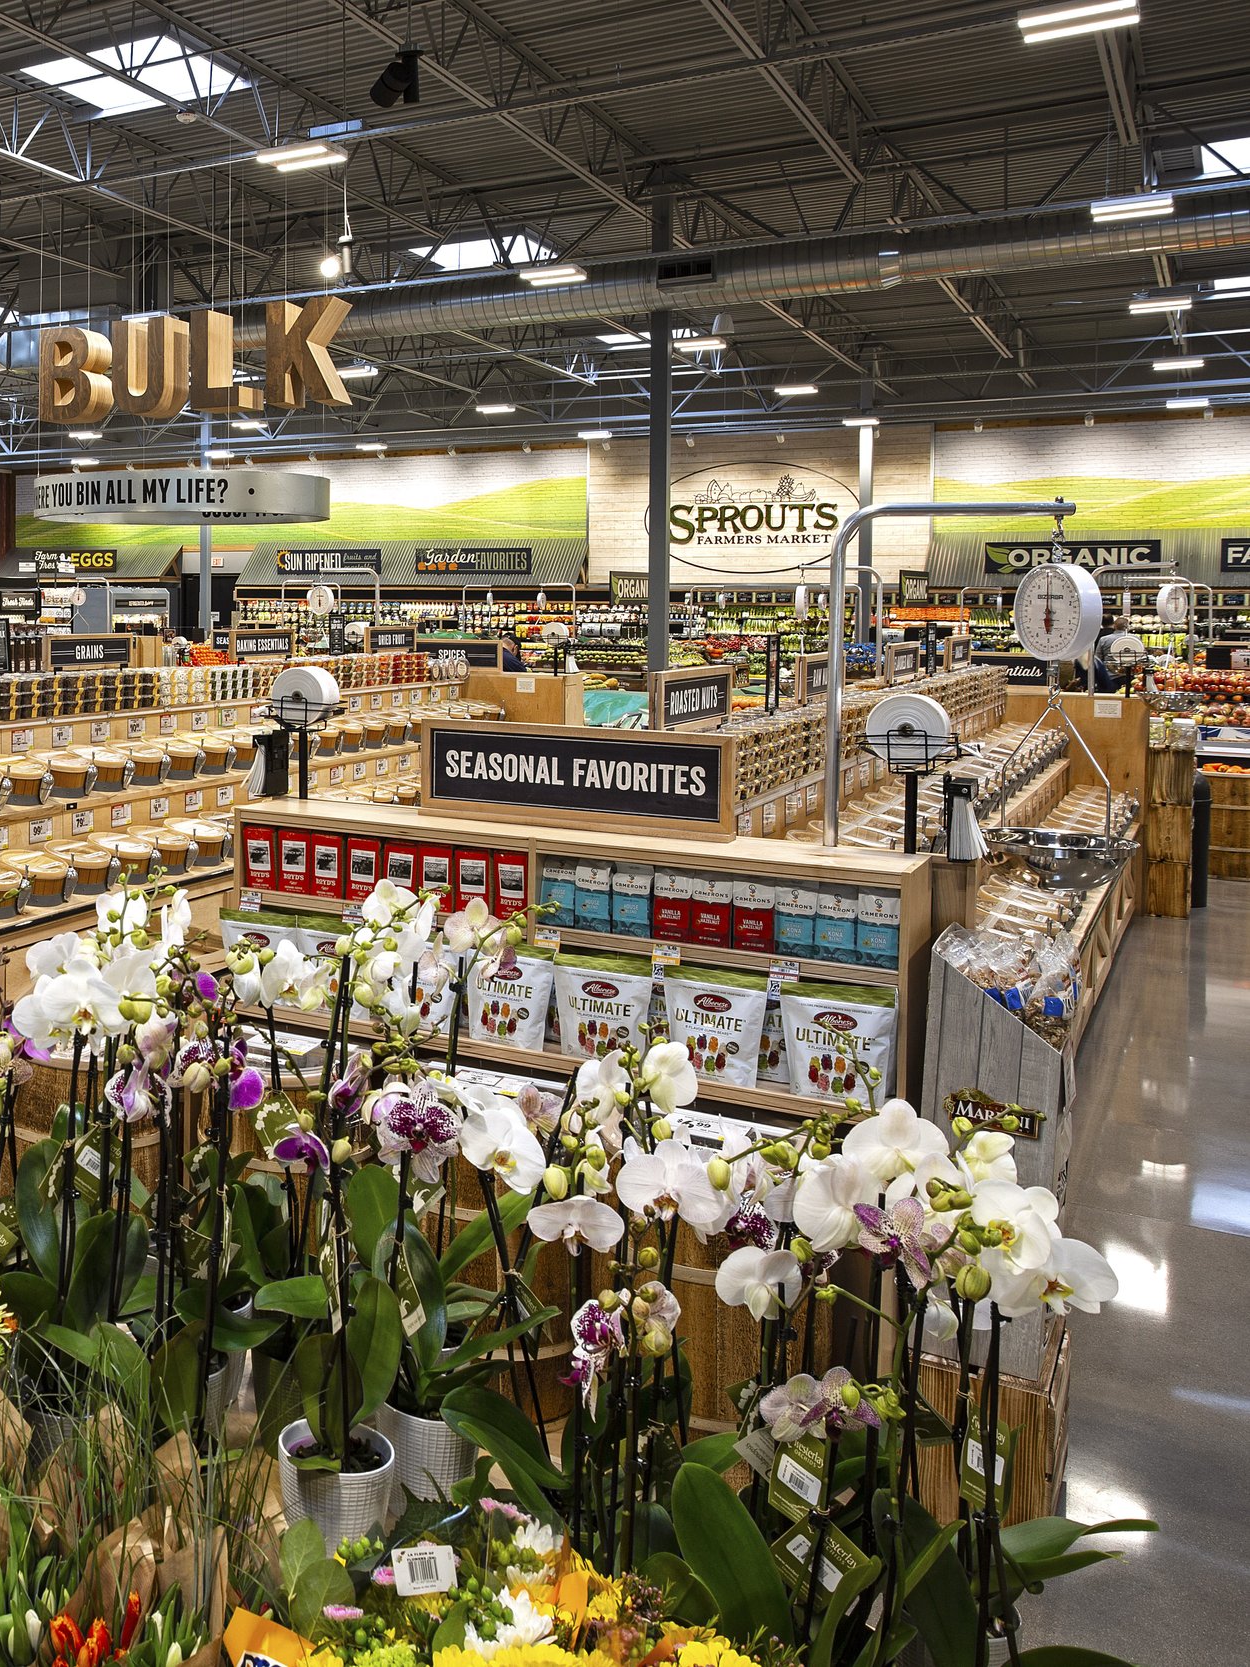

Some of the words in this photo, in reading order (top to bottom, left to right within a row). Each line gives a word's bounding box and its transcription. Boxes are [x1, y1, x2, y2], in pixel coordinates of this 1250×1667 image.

[40, 296, 353, 425] BULK
[52, 482, 72, 507] YOU
[77, 481, 101, 505] BIN
[105, 480, 136, 505] ALL
[142, 479, 170, 504] MY
[177, 478, 229, 504] LIFE?
[669, 502, 838, 545] SPROUTS
[697, 535, 762, 545] FARMERS
[767, 534, 832, 545] MARKET
[35, 550, 58, 561] Farm
[71, 552, 114, 568] EGGS
[425, 548, 477, 565] Garden
[476, 551, 527, 570] FAVORITES
[1008, 547, 1150, 567] ORGANIC
[37, 560, 59, 570] Fres
[285, 552, 302, 571] SUN
[305, 552, 341, 570] RIPENED
[618, 578, 648, 598] ORGANI
[906, 578, 928, 600] ORGANIC
[237, 639, 257, 652] BAKING
[258, 637, 289, 651] ESSENTIALS
[75, 645, 104, 660] GRAINS
[438, 649, 466, 661] SPICES
[669, 689, 700, 716] ROASTED
[701, 684, 718, 710] NUTS
[445, 750, 564, 786] SEASONAL
[572, 758, 706, 797] FAVORITES
[250, 870, 270, 878] BOYD'S
[283, 873, 304, 881] BOYD'S
[545, 868, 576, 876] CAMERON'S
[316, 878, 336, 886] BOYD'S
[351, 883, 373, 892] BOYD'S
[578, 878, 609, 886] CAMERON'S
[615, 882, 648, 890] CAMERON'S
[428, 890, 447, 898] OYD'S
[656, 885, 689, 894] CAMERON'S
[694, 889, 729, 899] CAMERON'S
[500, 898, 523, 906] BOYD'S
[735, 895, 771, 904] CAMERON'S
[777, 901, 813, 910] CAMERON'S
[819, 904, 855, 914] CAMERON'S
[661, 908, 681, 916] VANILLA
[700, 912, 720, 920] VANILLA
[861, 910, 899, 919] CAMERON'S
[828, 931, 843, 939] KONA
[871, 937, 887, 945] KONA
[476, 979, 533, 999] ULTIMATE
[568, 995, 631, 1017] ULTIMATE
[675, 1008, 743, 1033] ULTIMATE
[796, 1027, 871, 1051] ULTIMATE
[955, 1100, 1031, 1129] MARI
[794, 1449, 817, 1468] ORCHIDS
[825, 1536, 857, 1569] esterlay
